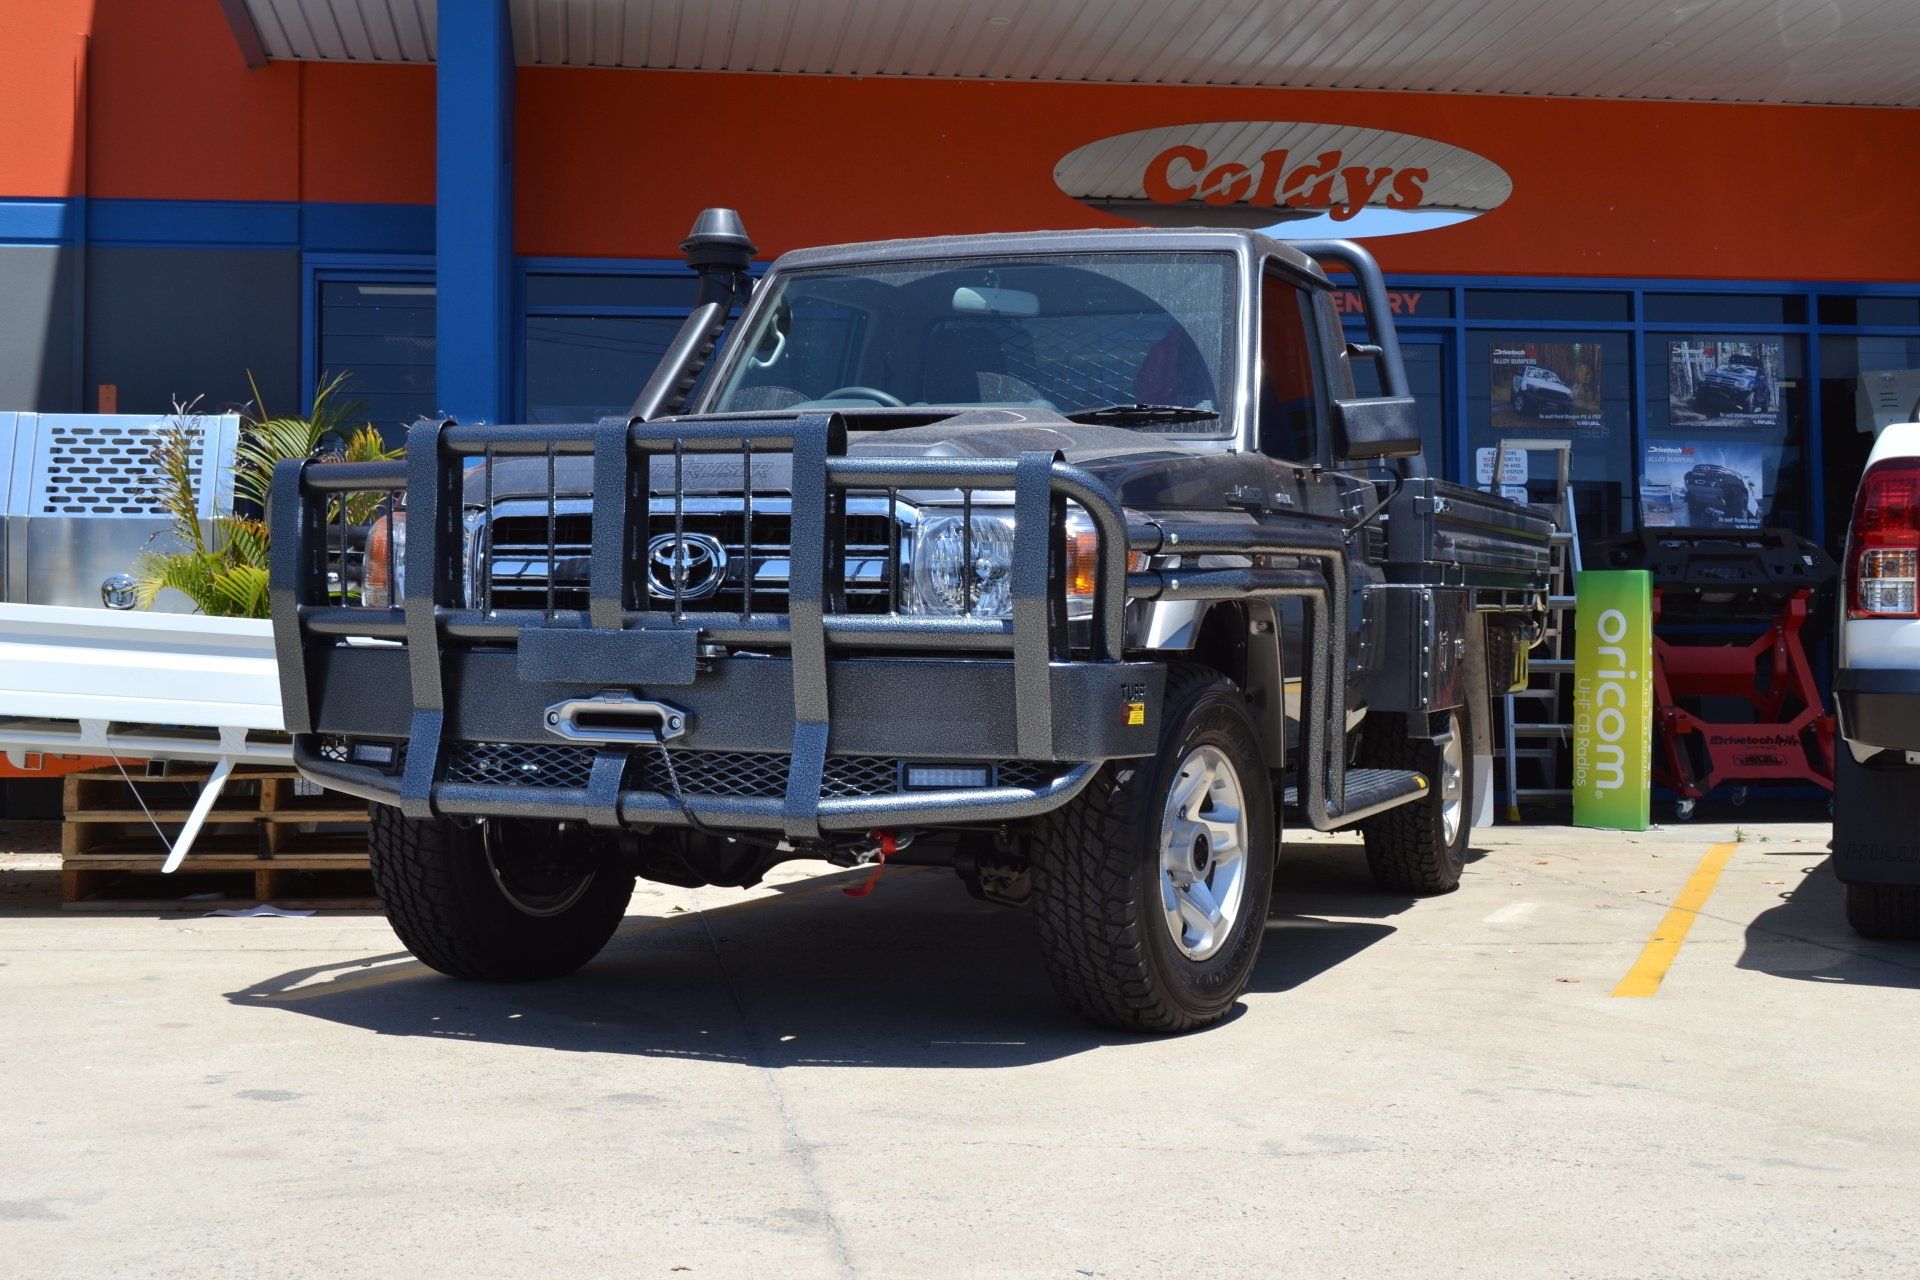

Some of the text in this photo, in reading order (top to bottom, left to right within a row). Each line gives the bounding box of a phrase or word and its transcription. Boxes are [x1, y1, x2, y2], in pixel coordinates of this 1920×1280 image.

[1143, 145, 1429, 222] Coldys
[1332, 291, 1421, 314] ENRY
[1120, 683, 1146, 701] TUFF
[1595, 609, 1637, 789] oricom
[1576, 678, 1591, 787] UHF CB Radios
[1846, 844, 1920, 864] HILU
